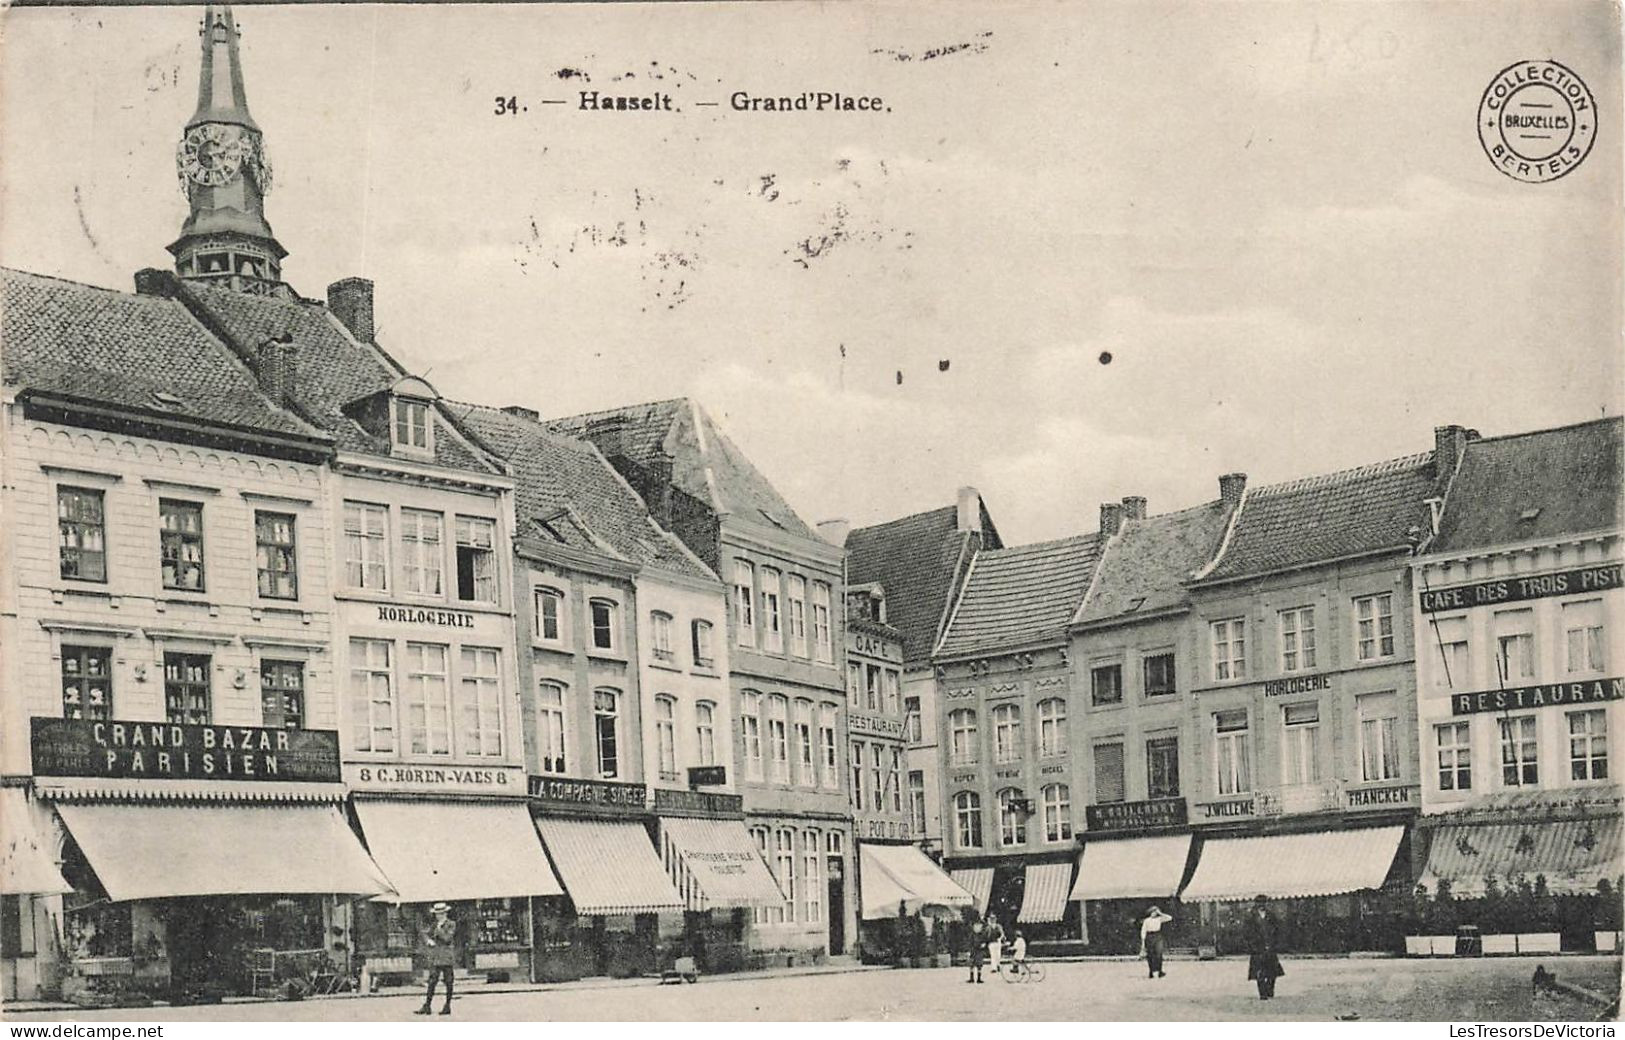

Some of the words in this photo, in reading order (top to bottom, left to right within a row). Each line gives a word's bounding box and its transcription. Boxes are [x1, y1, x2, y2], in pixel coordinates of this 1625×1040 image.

[1487, 66, 1589, 111] COLLECTION
[494, 96, 528, 115] 34.
[578, 91, 681, 112] Hasselt.
[731, 92, 892, 112] Grand'Place.
[1505, 115, 1569, 129] BRUXELLES
[1492, 144, 1581, 176] BERTELS
[1476, 583, 1508, 602] DES
[1519, 575, 1568, 597] TROIS
[378, 607, 475, 628] HORLOGERIE
[1264, 676, 1331, 697] HORLOGERIE
[849, 715, 902, 733] RESTAURANT
[94, 723, 183, 747] GRAND
[203, 728, 289, 750] BAZAR
[106, 751, 278, 774] PARISIEN
[360, 768, 371, 781] 8
[497, 771, 507, 784] 8
[529, 780, 545, 798] LA
[610, 786, 646, 805] SINGER
[1349, 788, 1409, 806] FRANCKEN
[869, 820, 886, 837] POT
